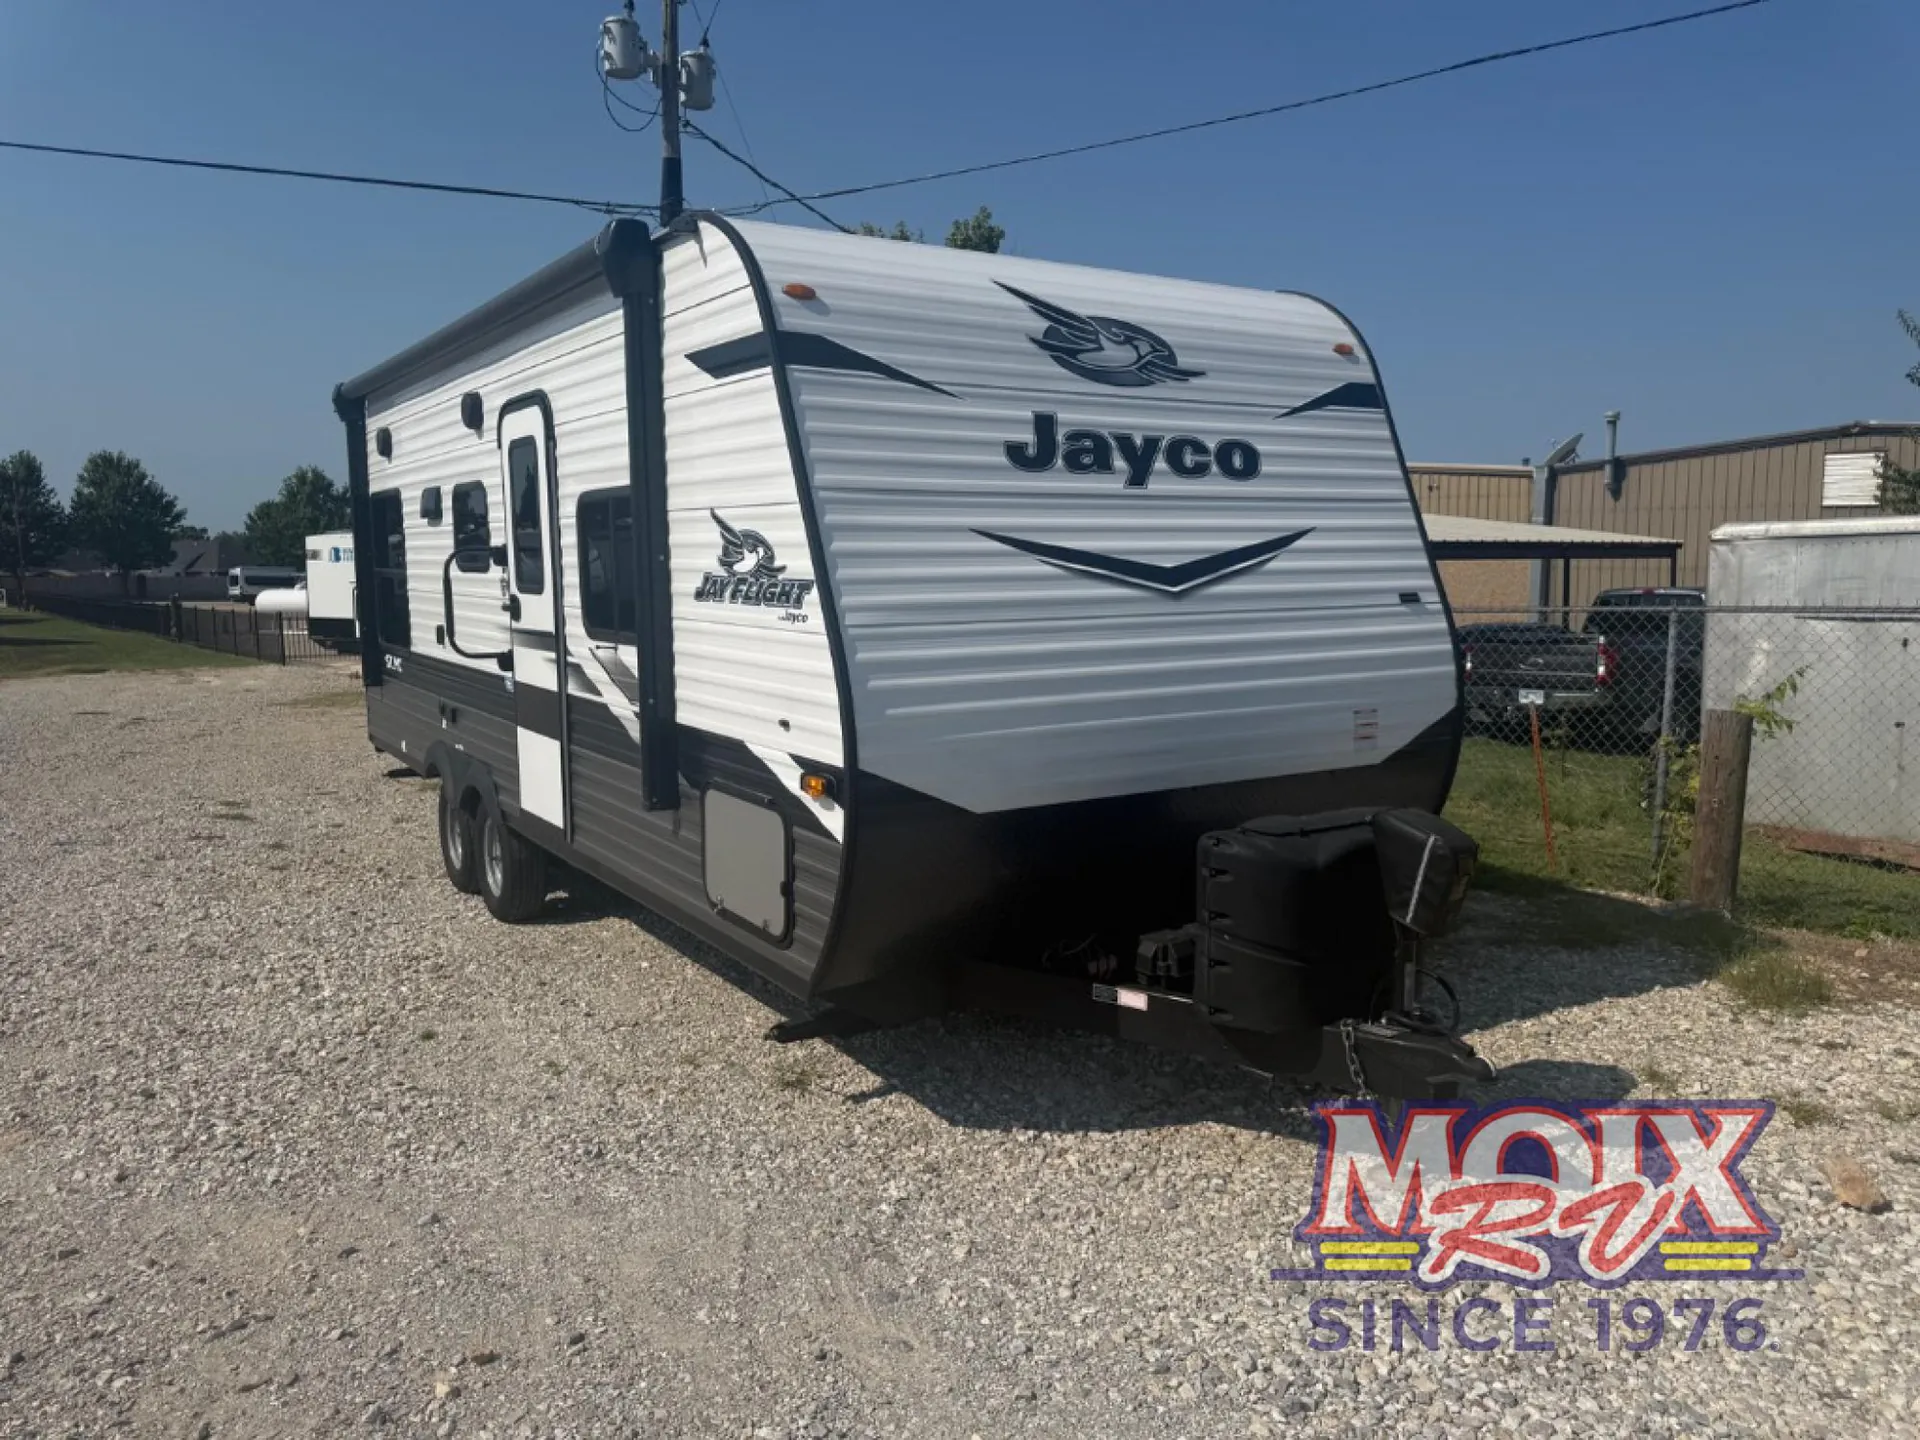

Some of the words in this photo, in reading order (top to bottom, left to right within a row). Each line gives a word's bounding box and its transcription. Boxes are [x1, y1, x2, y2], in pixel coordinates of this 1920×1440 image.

[1002, 411, 1262, 489] Jayco
[694, 571, 731, 602] JAY
[728, 577, 814, 610] FLIGHT
